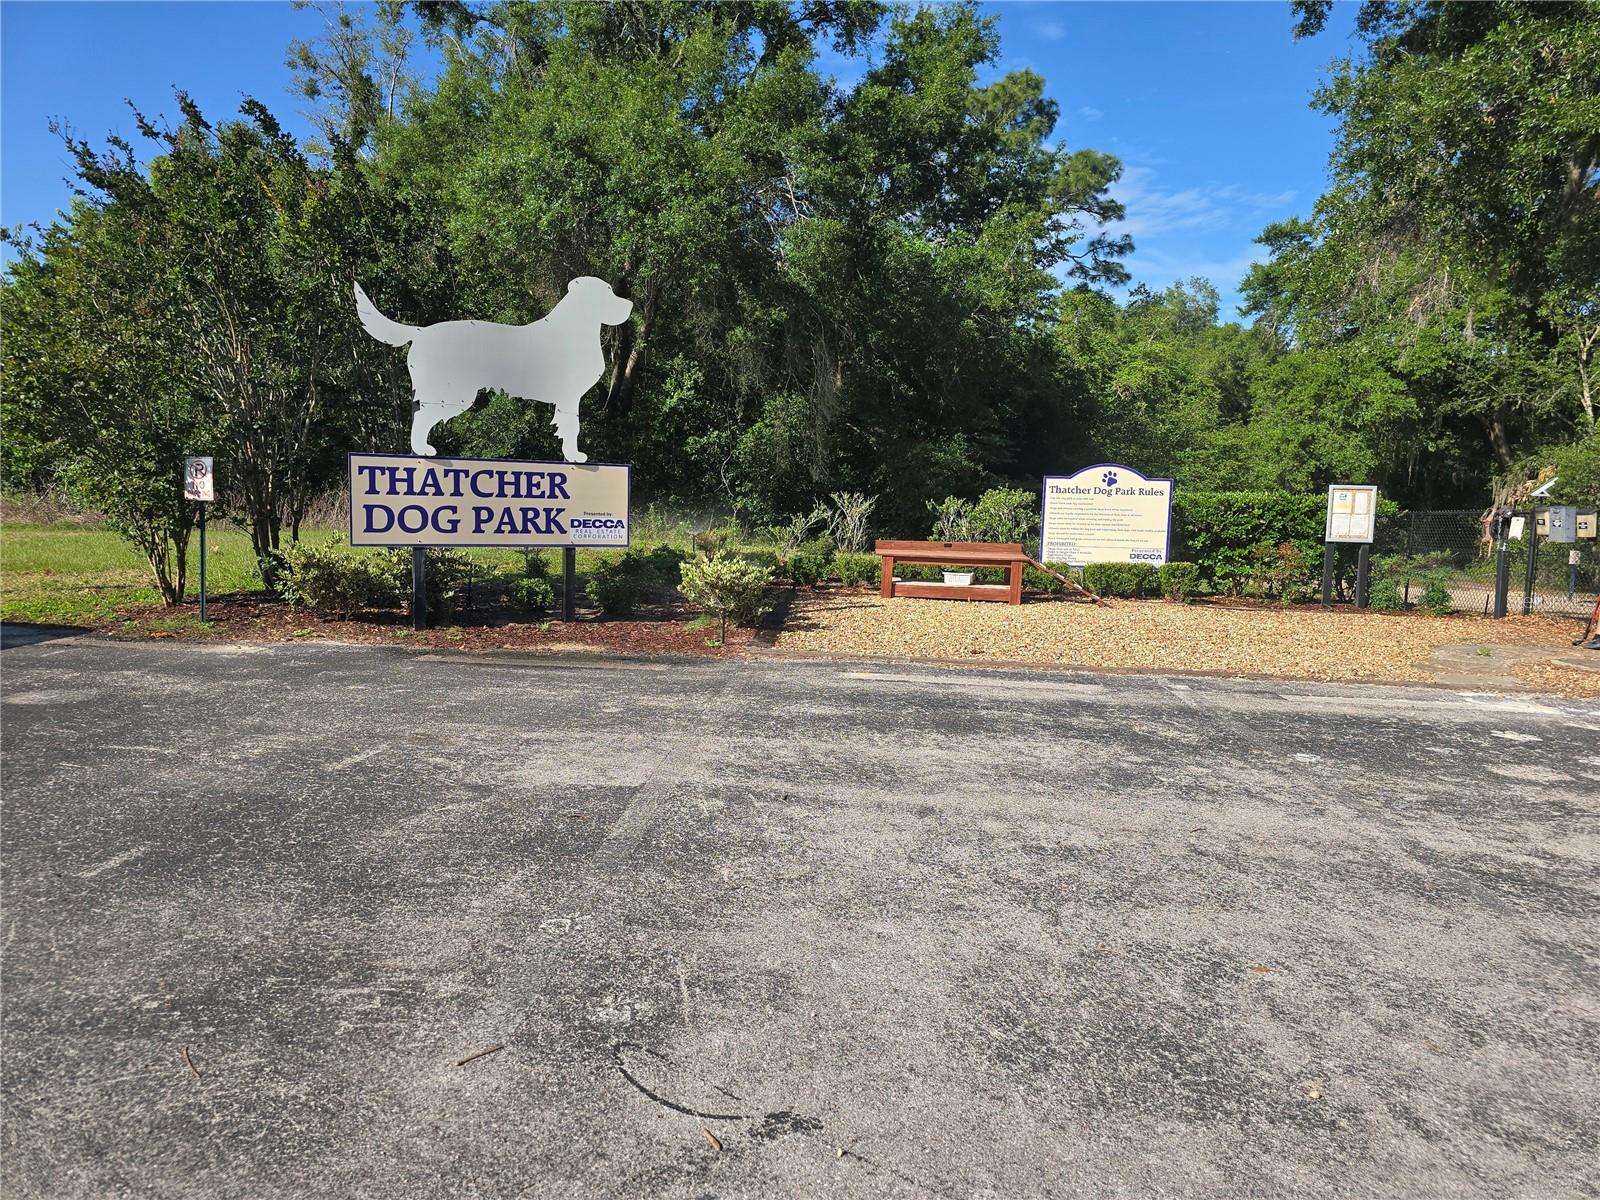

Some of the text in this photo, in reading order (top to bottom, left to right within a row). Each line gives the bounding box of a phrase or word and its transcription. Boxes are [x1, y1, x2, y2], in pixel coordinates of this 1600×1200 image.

[358, 465, 571, 500] THATCHER
[1049, 485, 1165, 497] Thatcher Dog Park Rules
[362, 504, 568, 535] DOG PARK
[570, 518, 625, 529] DECCA
